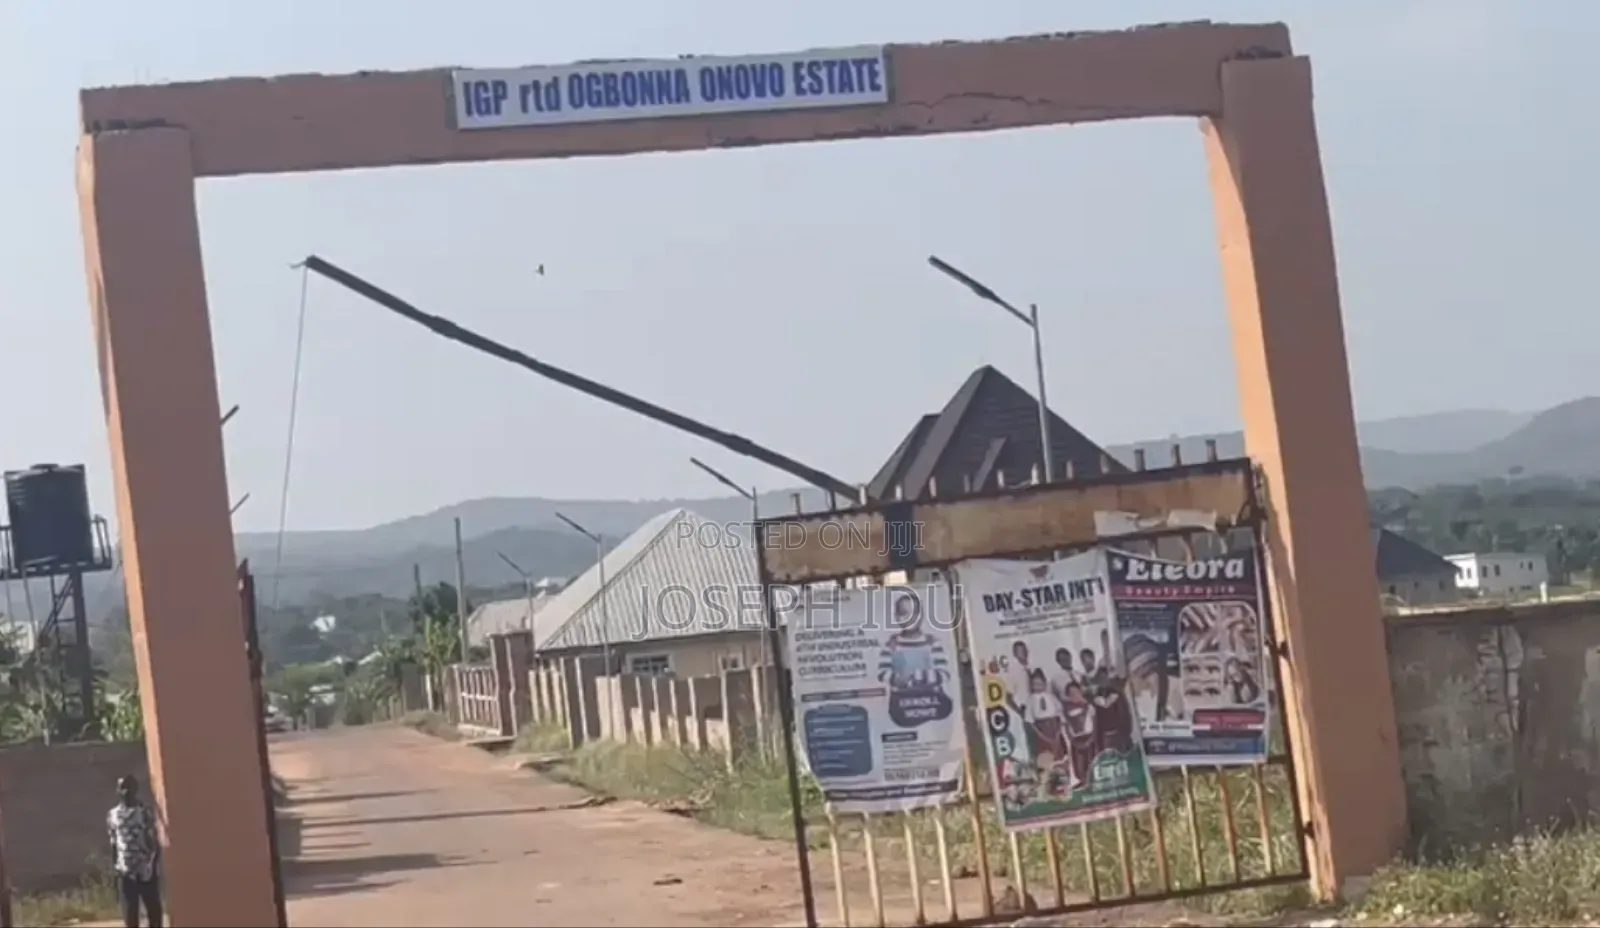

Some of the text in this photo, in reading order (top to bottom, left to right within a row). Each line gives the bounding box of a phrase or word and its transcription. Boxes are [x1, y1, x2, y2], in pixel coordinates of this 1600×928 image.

[463, 57, 882, 117] IGP rtd OGBONNA ONOVO ESTATE
[982, 583, 1067, 613] DAY-STAR
[988, 682, 1002, 702] D
[990, 711, 1006, 730] C
[996, 736, 1011, 757] B
